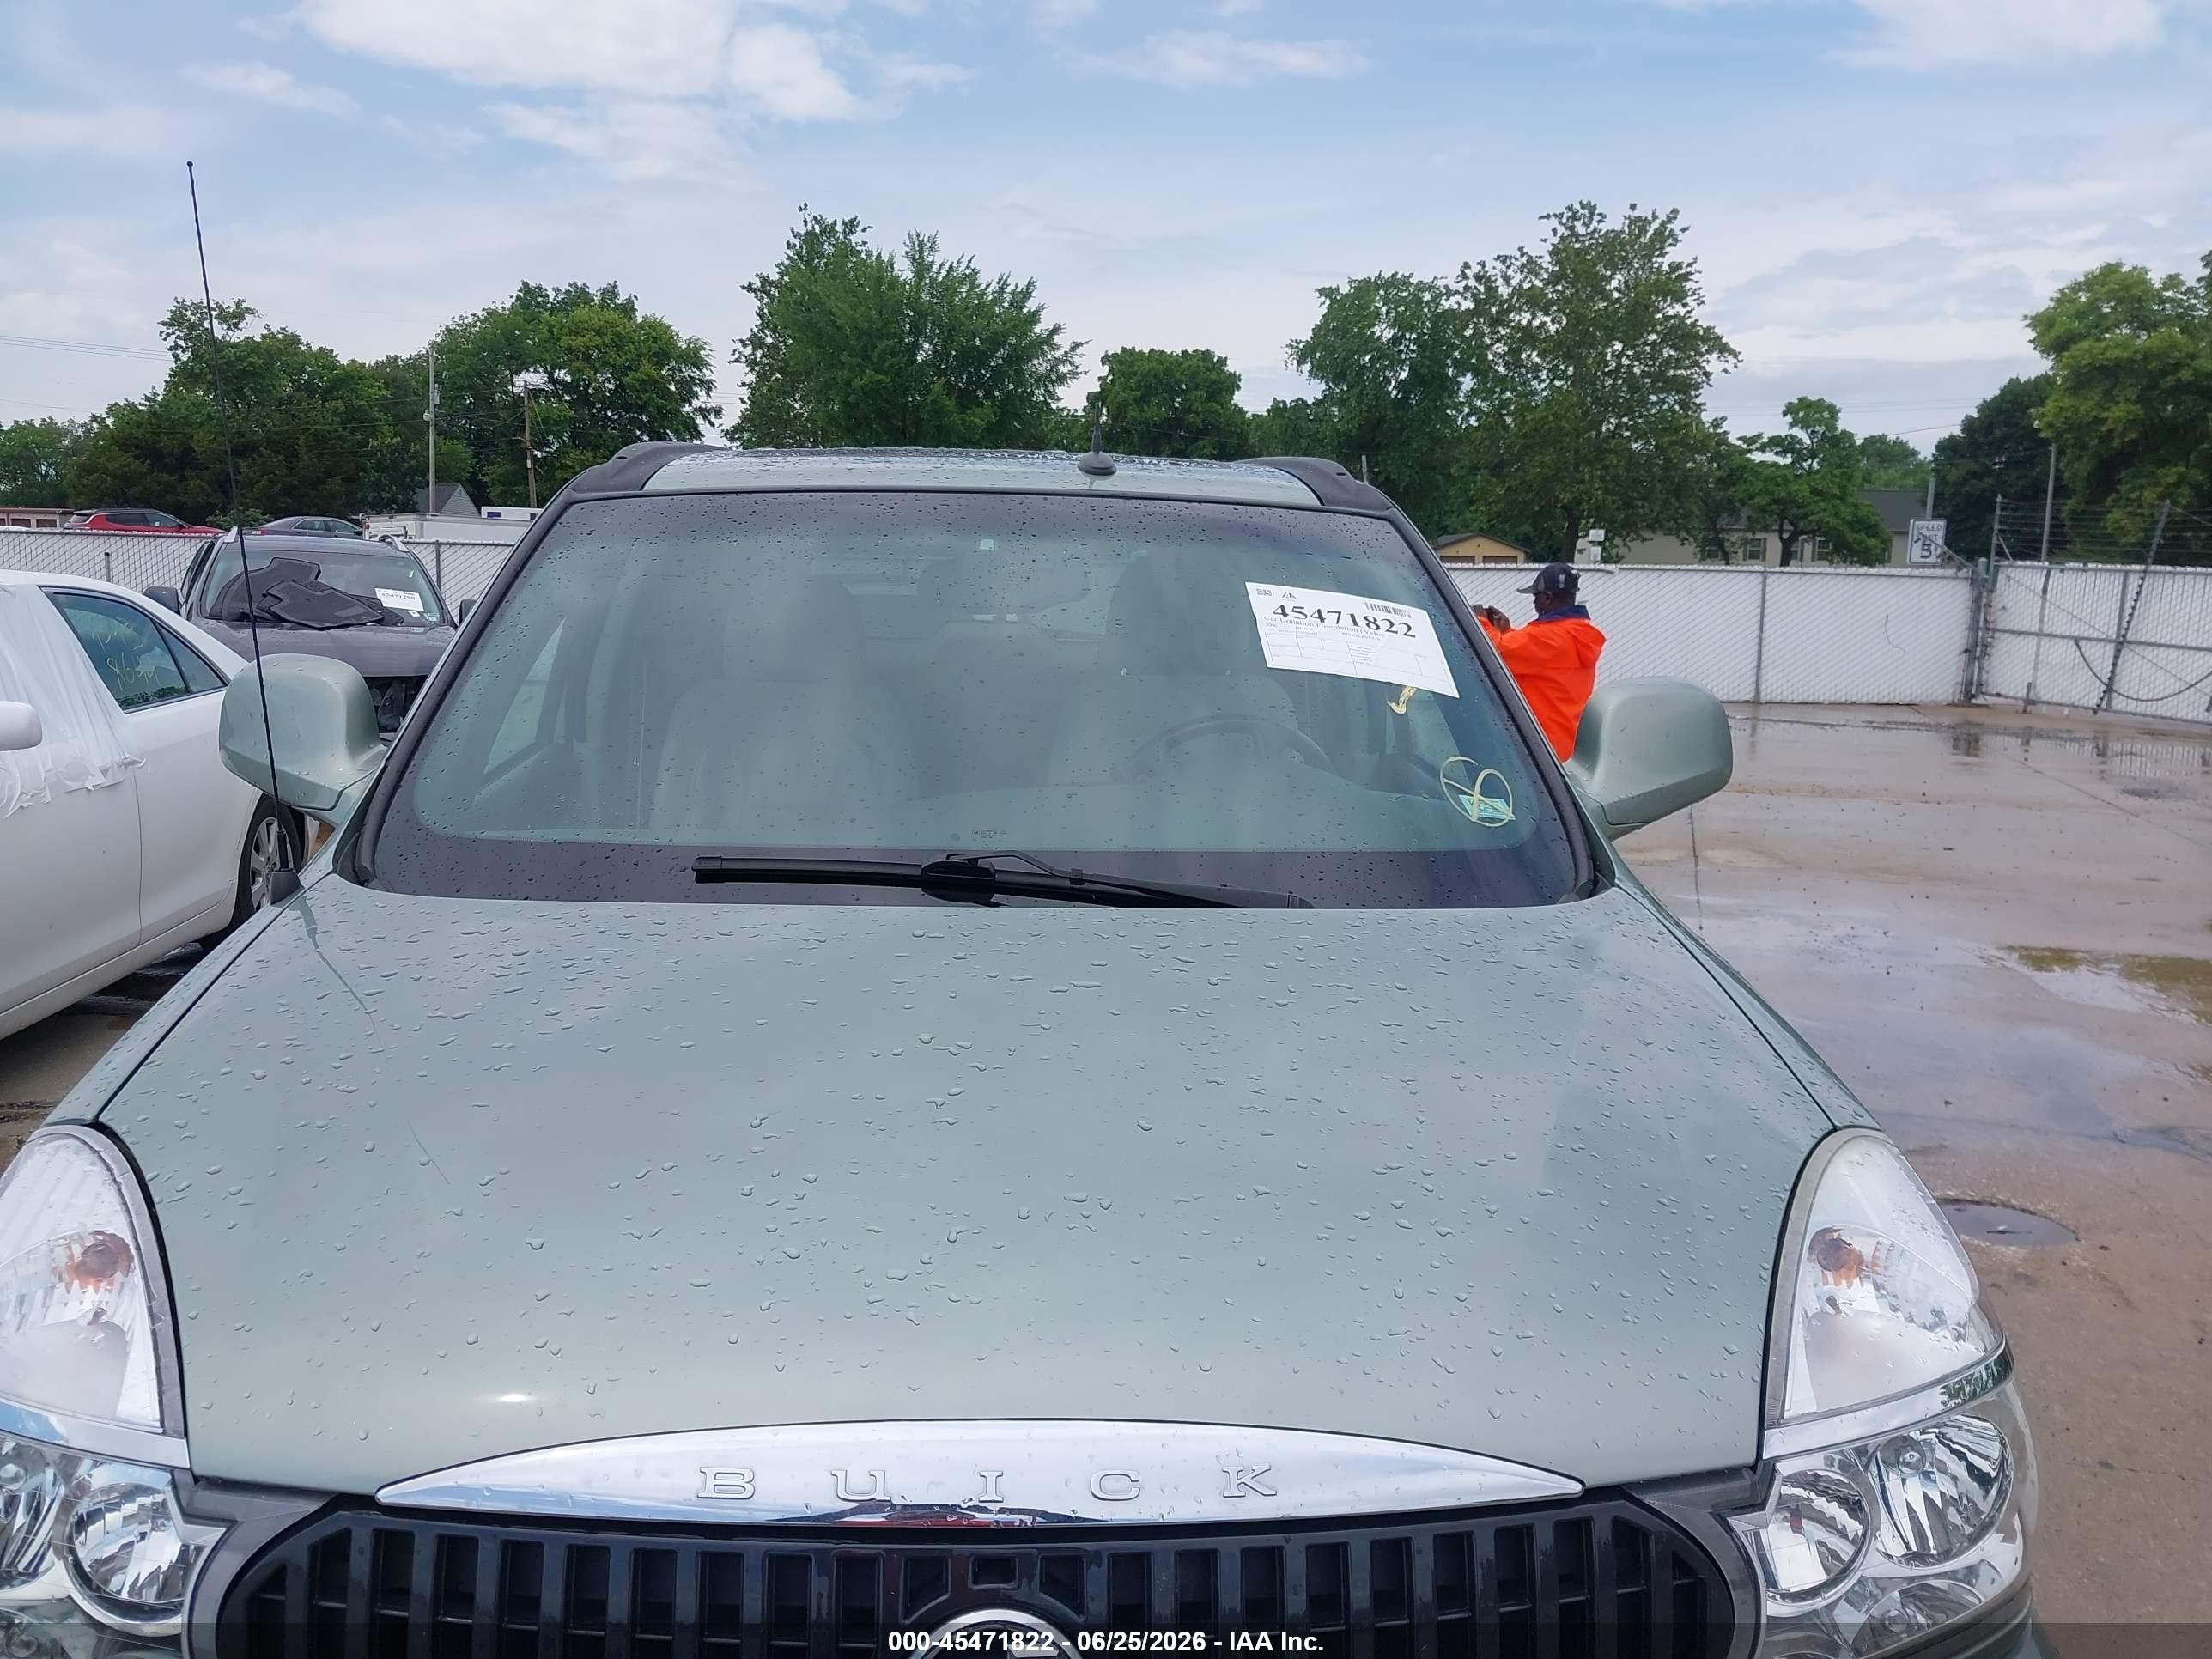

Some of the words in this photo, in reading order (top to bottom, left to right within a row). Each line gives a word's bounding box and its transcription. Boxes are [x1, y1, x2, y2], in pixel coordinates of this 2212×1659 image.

[1920, 544, 1932, 558] 5
[1273, 604, 1416, 638] 45471822
[1279, 617, 1316, 628] Donation
[696, 1463, 1278, 1504] BUICK
